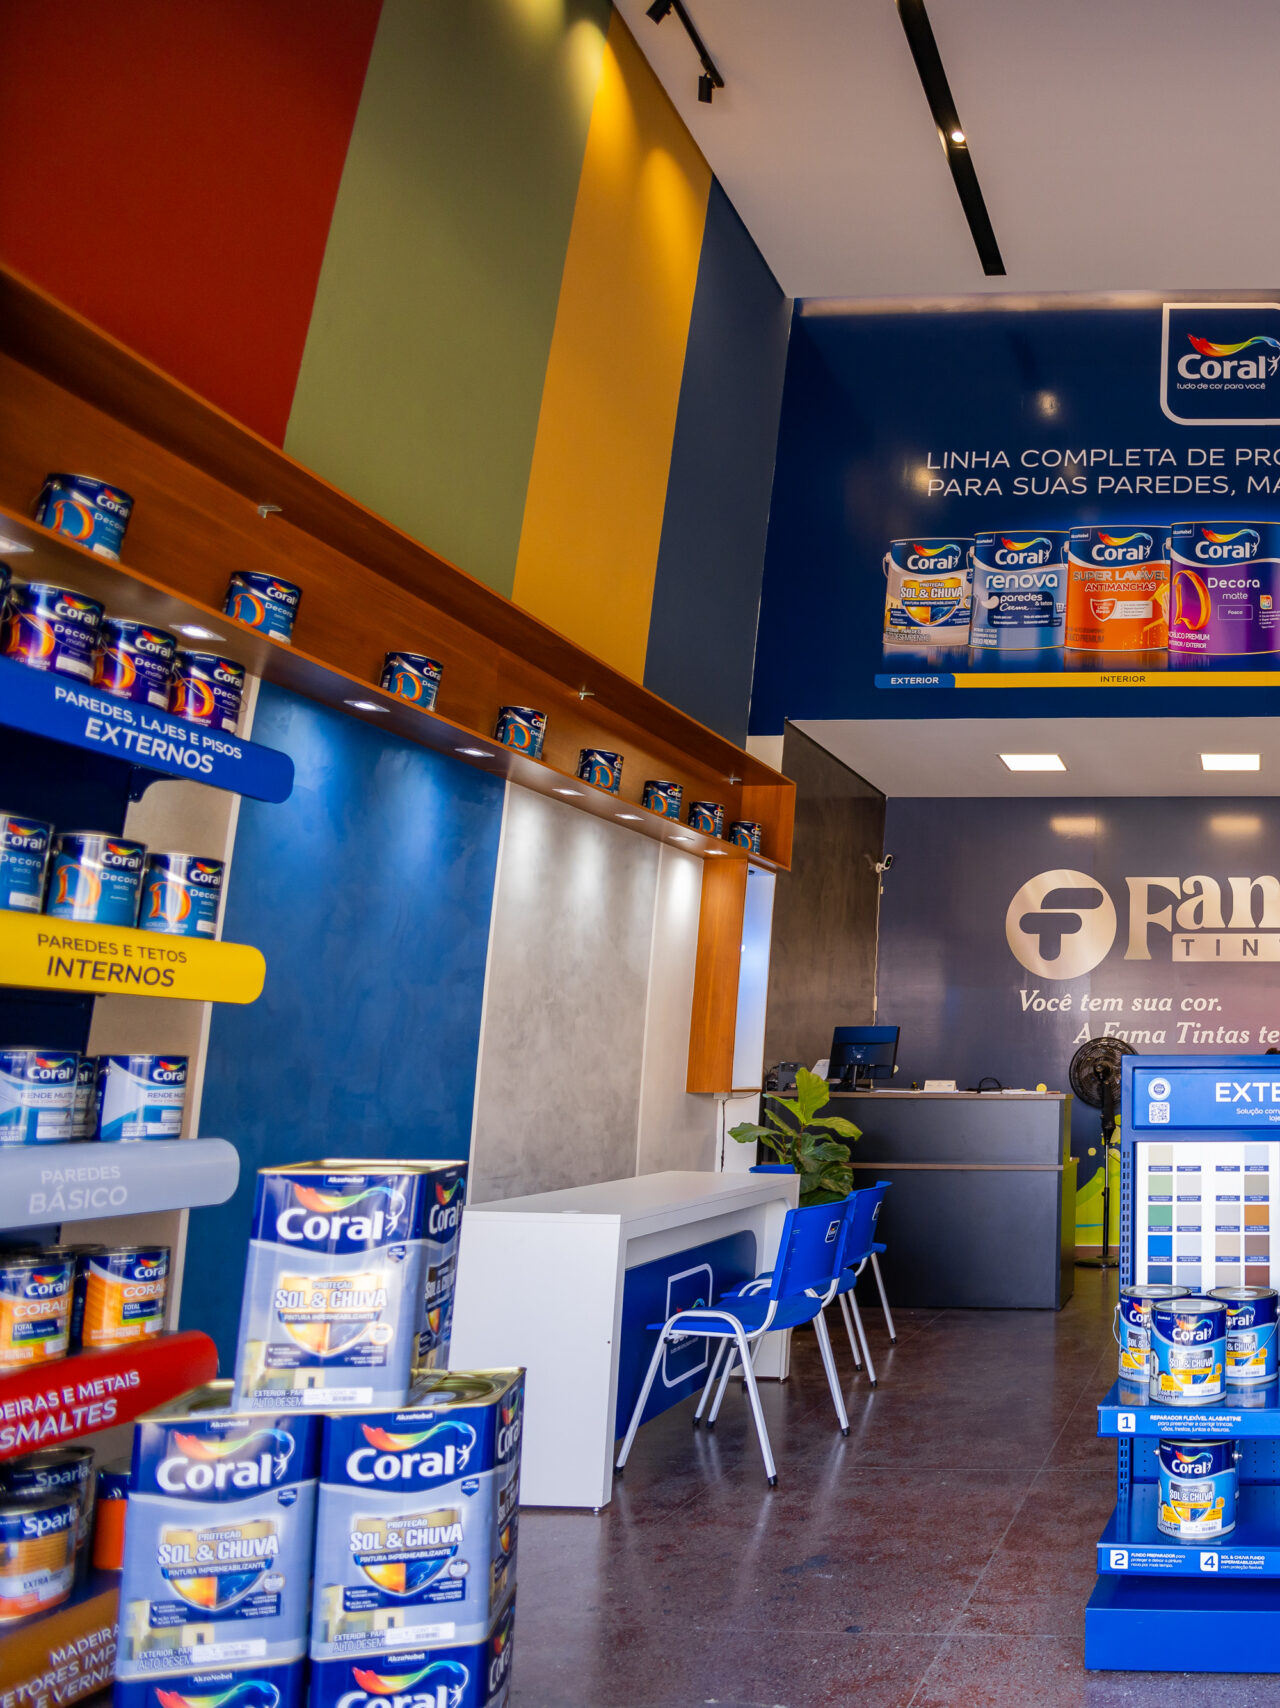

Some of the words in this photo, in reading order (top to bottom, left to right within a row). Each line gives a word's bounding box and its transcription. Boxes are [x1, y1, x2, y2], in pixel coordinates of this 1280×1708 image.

[1177, 353, 1266, 380] Coral
[1176, 382, 1196, 390] tudo
[1197, 382, 1208, 390] de
[1245, 382, 1266, 390] você
[926, 450, 1011, 469] LINHA
[1020, 449, 1177, 467] COMPLETA
[1187, 448, 1225, 466] DE
[927, 477, 1003, 496] PARA
[1012, 476, 1088, 496] SUAS
[1097, 475, 1236, 497] PAREDES,
[96, 494, 129, 518] Coral
[994, 549, 1044, 565] Coral
[1091, 544, 1143, 561] Coral
[1195, 541, 1250, 559] Coral
[907, 554, 952, 570] Coral
[985, 573, 1058, 589] renova
[1073, 570, 1112, 581] SUPER
[1207, 577, 1261, 589] Decora
[900, 588, 917, 598] SOL
[919, 589, 929, 598] &
[930, 586, 963, 598] CHUVA
[1085, 582, 1157, 592] ANTIMANCHAS
[266, 586, 296, 605] Coral
[1000, 592, 1043, 604] paredes
[1222, 592, 1249, 600] matte
[55, 603, 99, 626] Coral
[54, 623, 95, 644] Decora
[135, 635, 171, 658] Coral
[890, 676, 939, 685] EXTERIOR
[1100, 675, 1146, 683] INTERIOR
[54, 686, 137, 727] PAREDES,
[140, 715, 187, 742] LAJES
[190, 731, 199, 746] E
[202, 737, 242, 760] PISOS
[84, 717, 215, 774] EXTERNOS
[101, 851, 140, 868] Coral
[100, 872, 138, 886] Decora
[190, 869, 222, 886] Coral
[37, 933, 119, 956] PAREDES
[123, 944, 133, 957] E
[137, 946, 188, 964] TETOS
[46, 956, 176, 988] INTERNOS
[1019, 989, 1072, 1011] Você
[1080, 996, 1123, 1011] tem
[1131, 997, 1174, 1011] sua
[1180, 997, 1222, 1011] cor.
[1073, 1023, 1093, 1044] A
[1102, 1022, 1166, 1044] Fama
[1176, 1021, 1250, 1044] Tintas
[27, 1065, 71, 1080] Coral
[147, 1091, 173, 1099] RENDE
[1236, 1107, 1264, 1116] Solução
[41, 1165, 121, 1185] PAREDES
[28, 1183, 128, 1215] BÁSICO
[275, 1207, 385, 1241] Coral
[428, 1205, 458, 1235] Coral
[134, 1265, 167, 1279] Coral
[26, 1280, 68, 1296] Coral
[275, 1288, 308, 1310] SOL
[311, 1293, 327, 1309] &
[329, 1288, 387, 1308] CHUVA
[13, 1322, 33, 1332] TOTAL
[1172, 1328, 1208, 1341] Coral
[62, 1388, 75, 1403] E
[78, 1371, 141, 1400] METAIS
[0, 1399, 118, 1449] SMALTES
[210, 1420, 249, 1429] AkzoNobel
[396, 1412, 434, 1422] AkzoNobel
[1121, 1416, 1132, 1429] 1
[346, 1445, 455, 1482] Coral
[1171, 1460, 1207, 1474] Coral
[35, 1464, 90, 1488] Sparla
[156, 1454, 273, 1492] Coral
[350, 1531, 383, 1552] SOL
[386, 1530, 403, 1548] &
[405, 1523, 464, 1547] CHUVA
[158, 1543, 194, 1565] SOL
[196, 1544, 215, 1562] &
[217, 1535, 279, 1559] CHUVA
[360, 1553, 387, 1564] PINTURA
[1114, 1552, 1125, 1566] 2
[1204, 1555, 1216, 1568] 4
[168, 1567, 198, 1578] PINTURA
[23, 1575, 49, 1590] EXTRA
[50, 1623, 120, 1666] MADEIRA
[388, 1652, 426, 1663] AkzoNobel
[193, 1673, 233, 1683] AkzoNobel
